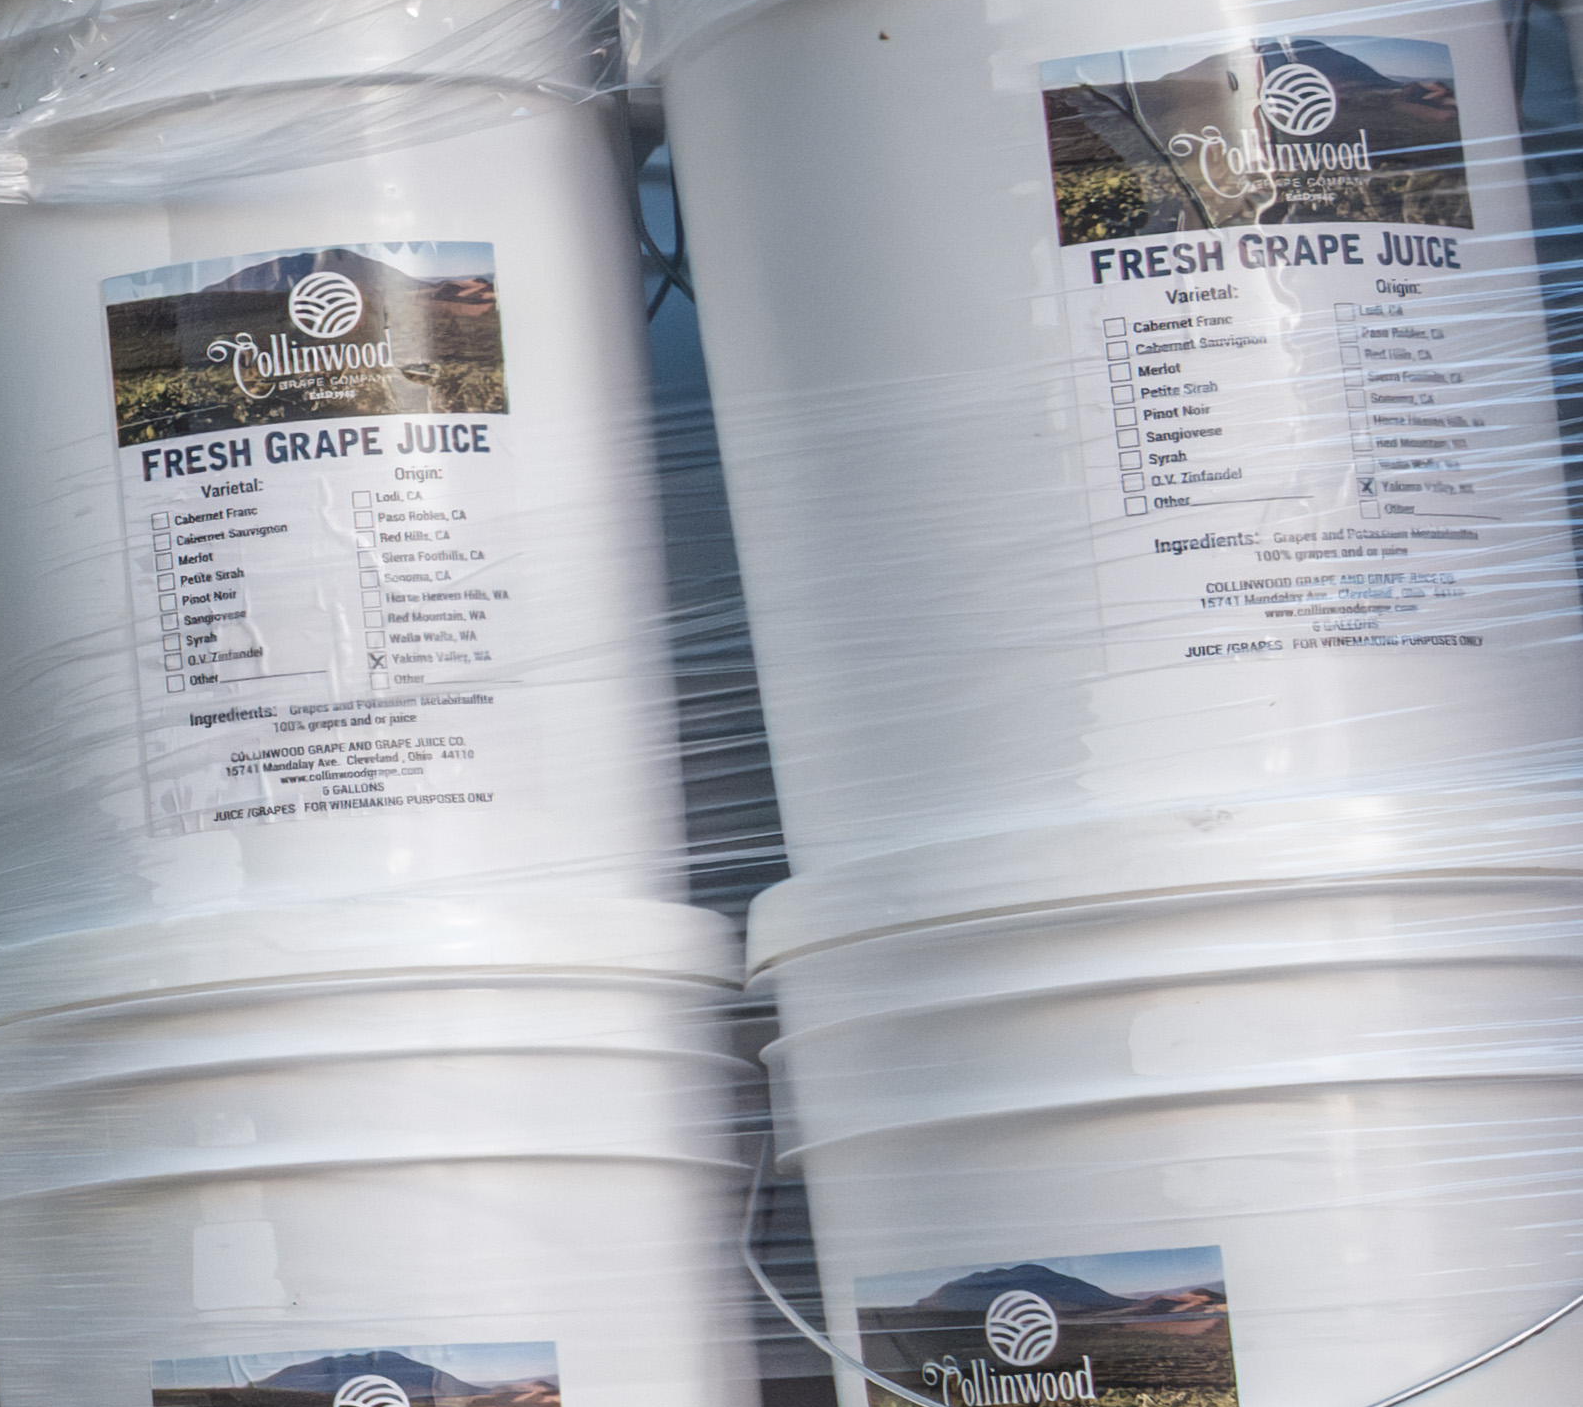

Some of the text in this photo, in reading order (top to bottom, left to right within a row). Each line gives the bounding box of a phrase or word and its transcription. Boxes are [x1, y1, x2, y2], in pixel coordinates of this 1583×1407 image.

[1090, 231, 1461, 284] FRESH GRAPE JUICE
[1165, 284, 1239, 304] Varietal:
[1376, 278, 1422, 297] Origin:
[1133, 318, 1192, 333] Cabernet
[206, 328, 394, 399] Collinwood
[1138, 363, 1181, 376] Merlot
[1146, 427, 1222, 443] Sangiovese
[142, 422, 490, 481] FRESH GRAPE JUICE
[1148, 450, 1187, 466] Syrah
[395, 466, 443, 483] Origin:
[201, 478, 264, 498] Varietal:
